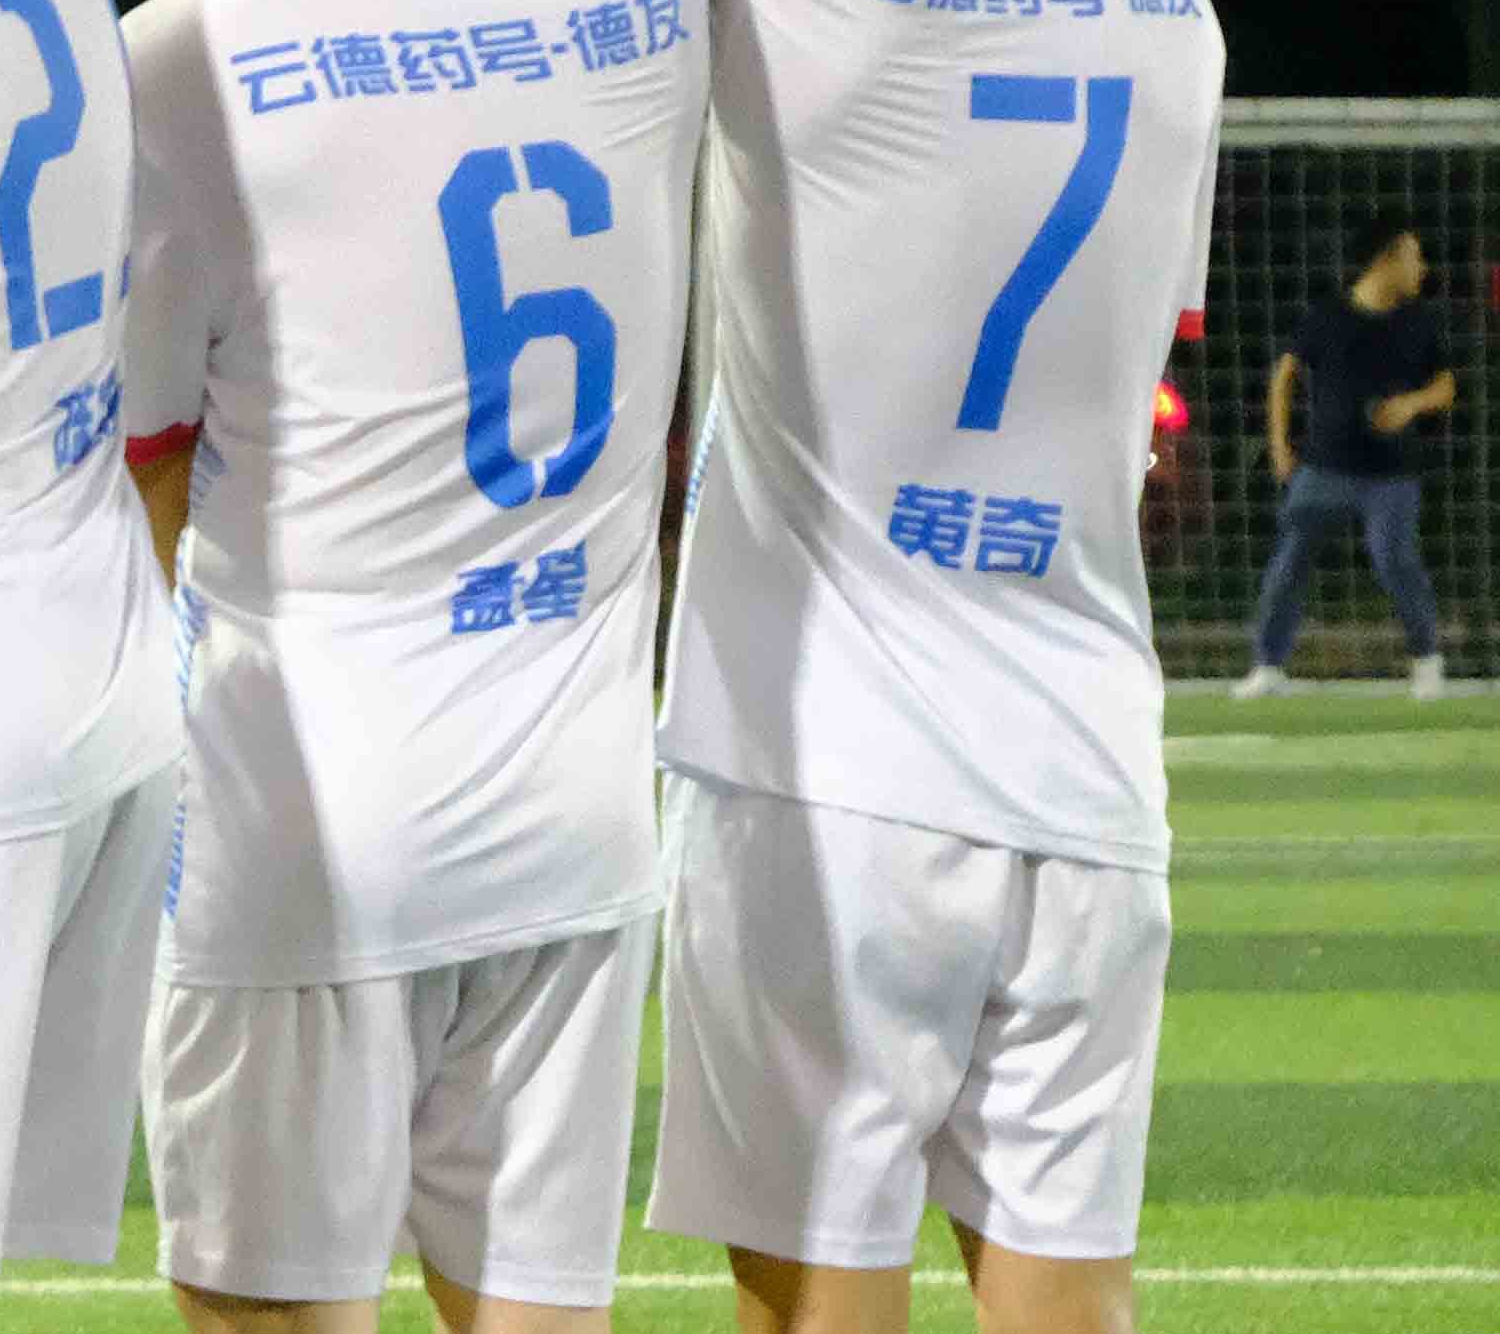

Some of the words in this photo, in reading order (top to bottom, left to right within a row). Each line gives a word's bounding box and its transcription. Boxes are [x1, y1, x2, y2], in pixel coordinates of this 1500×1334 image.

[438, 139, 618, 510] 6
[956, 75, 1133, 432] 7
[888, 482, 1063, 579] 黄奇
